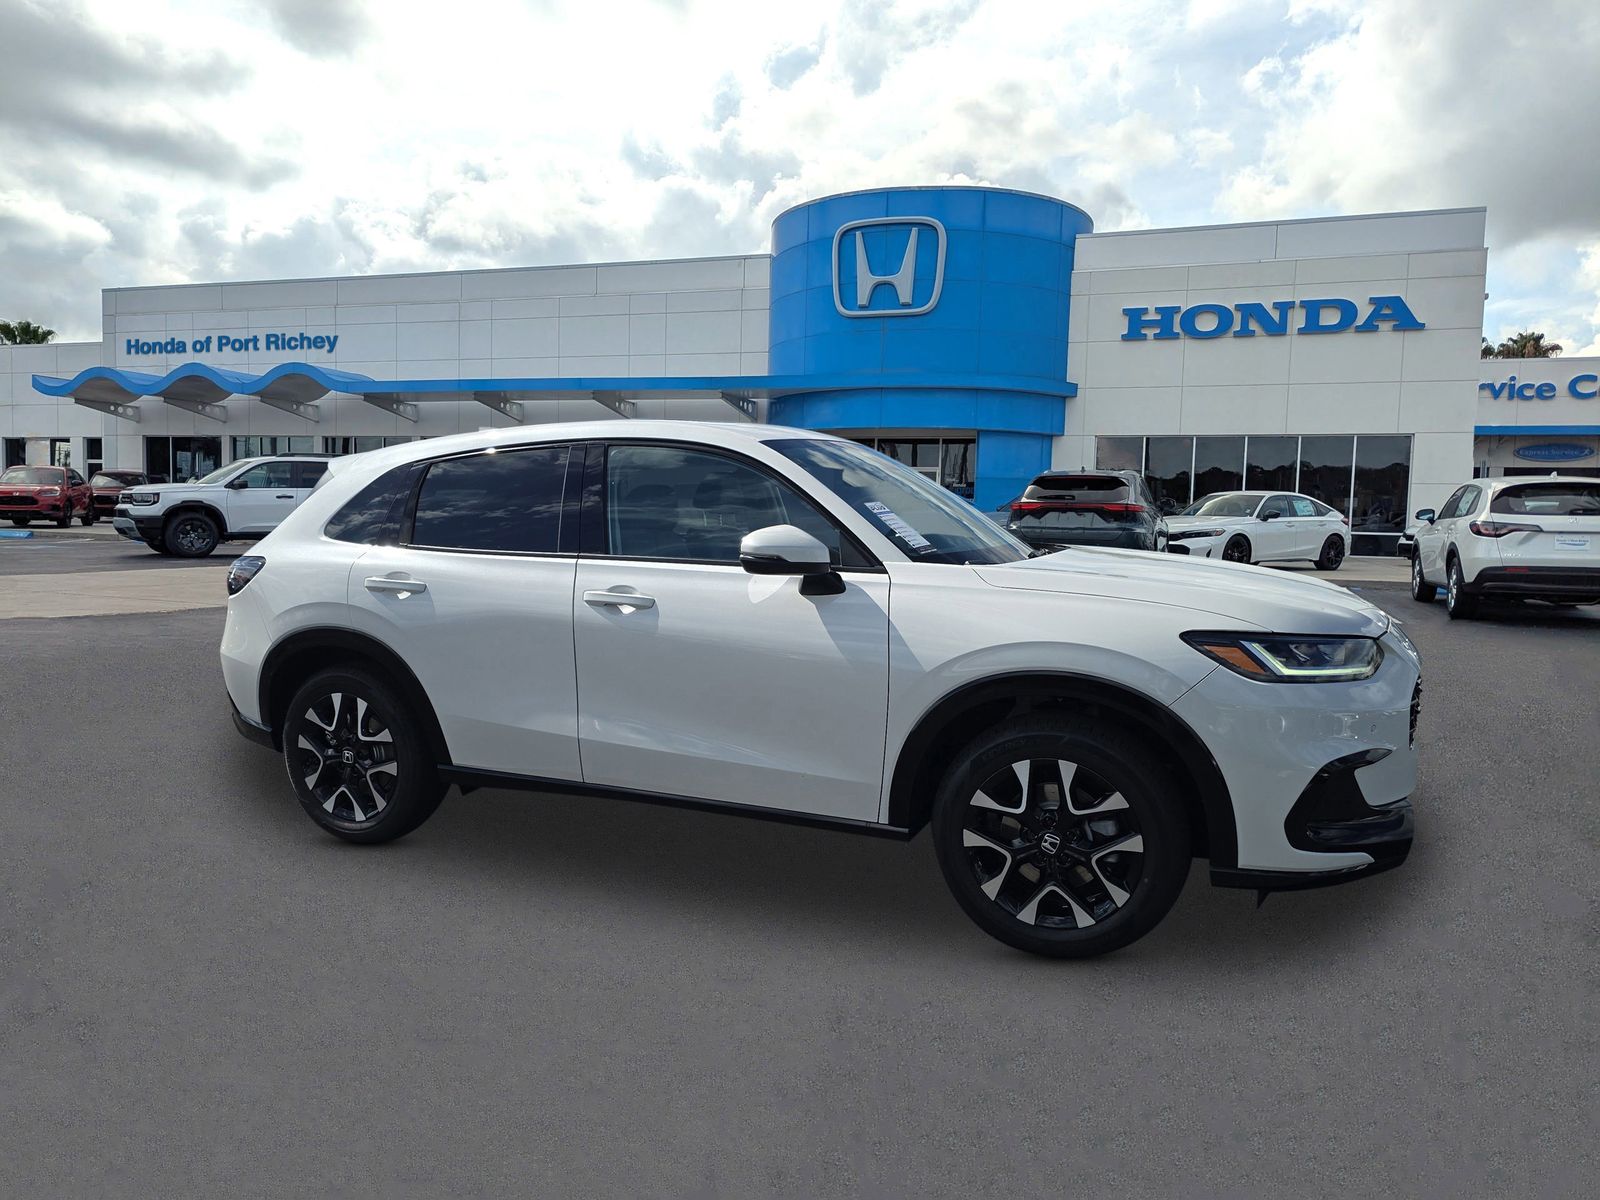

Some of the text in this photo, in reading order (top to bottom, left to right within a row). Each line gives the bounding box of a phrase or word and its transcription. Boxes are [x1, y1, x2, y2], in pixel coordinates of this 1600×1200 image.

[1121, 296, 1426, 341] HONDA
[126, 332, 339, 355] Honda of Port Richey
[1568, 374, 1600, 400] C
